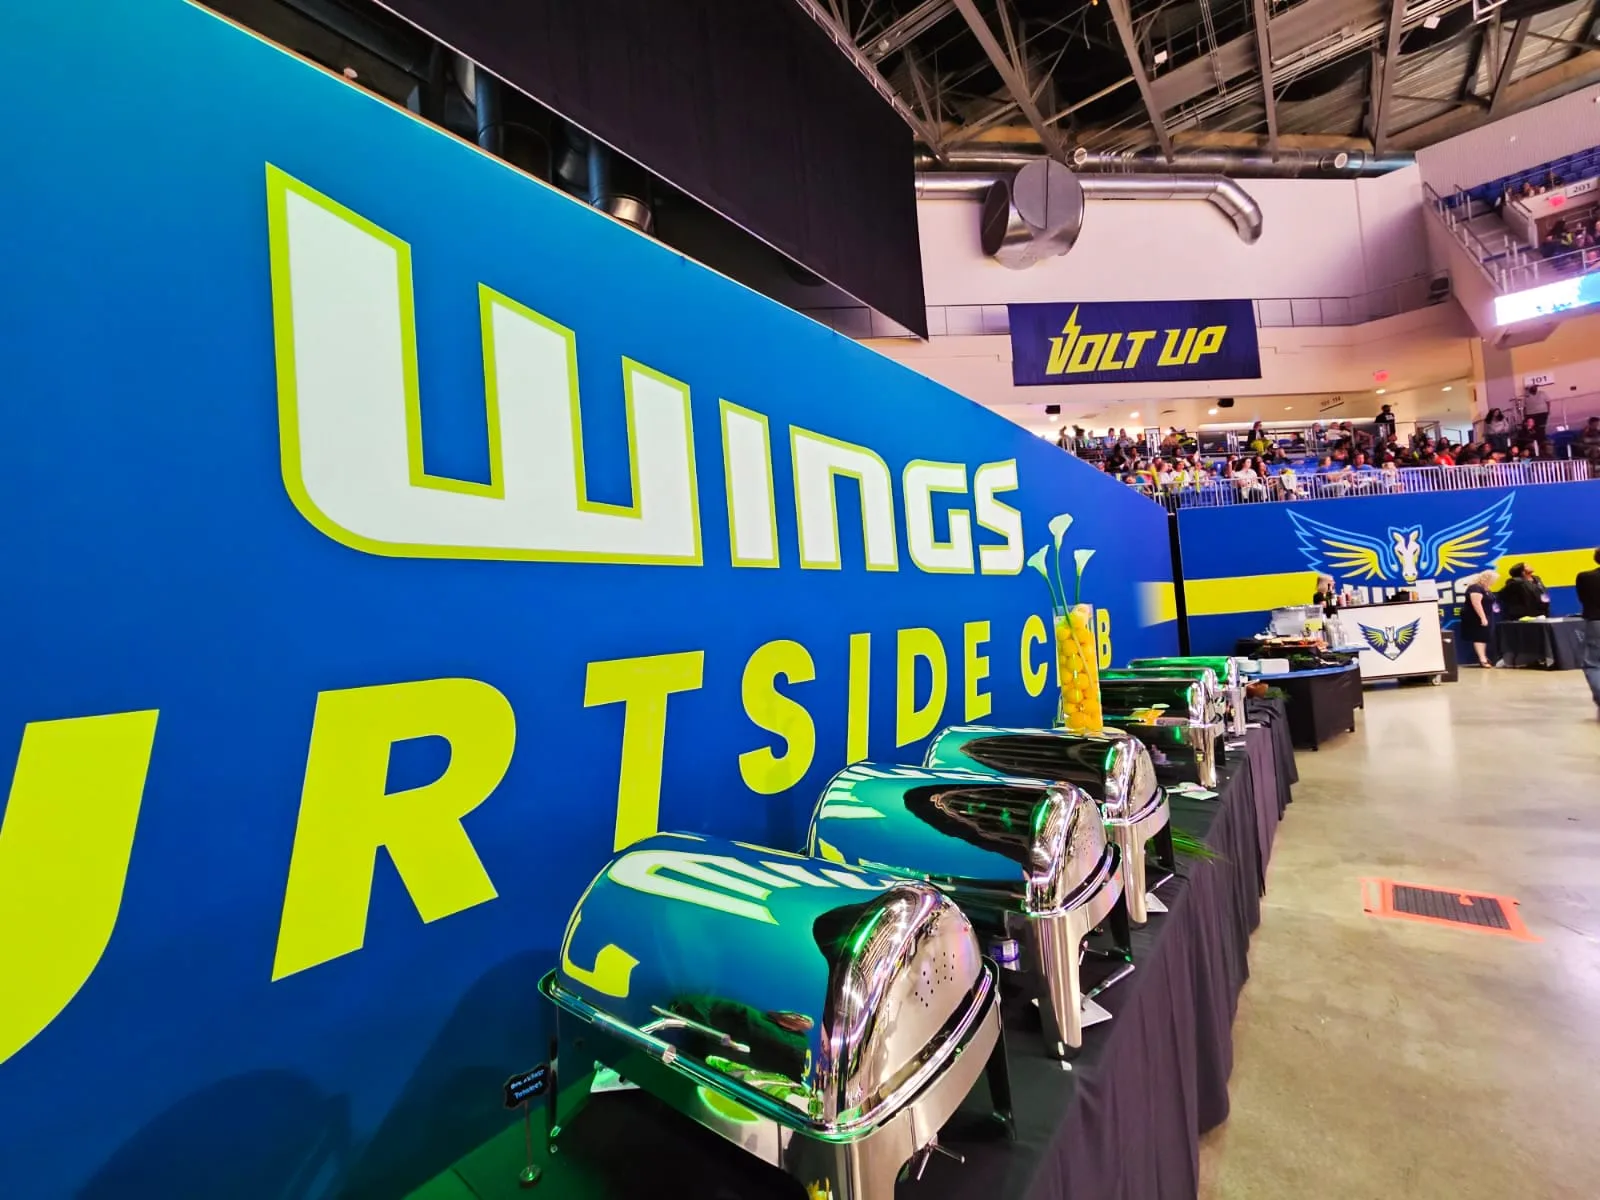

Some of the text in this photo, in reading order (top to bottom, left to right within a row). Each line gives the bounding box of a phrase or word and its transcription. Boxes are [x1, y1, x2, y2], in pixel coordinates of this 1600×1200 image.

[265, 161, 1025, 576] WINGS
[1045, 304, 1228, 375] VOLT UP
[1020, 608, 1112, 697] CB
